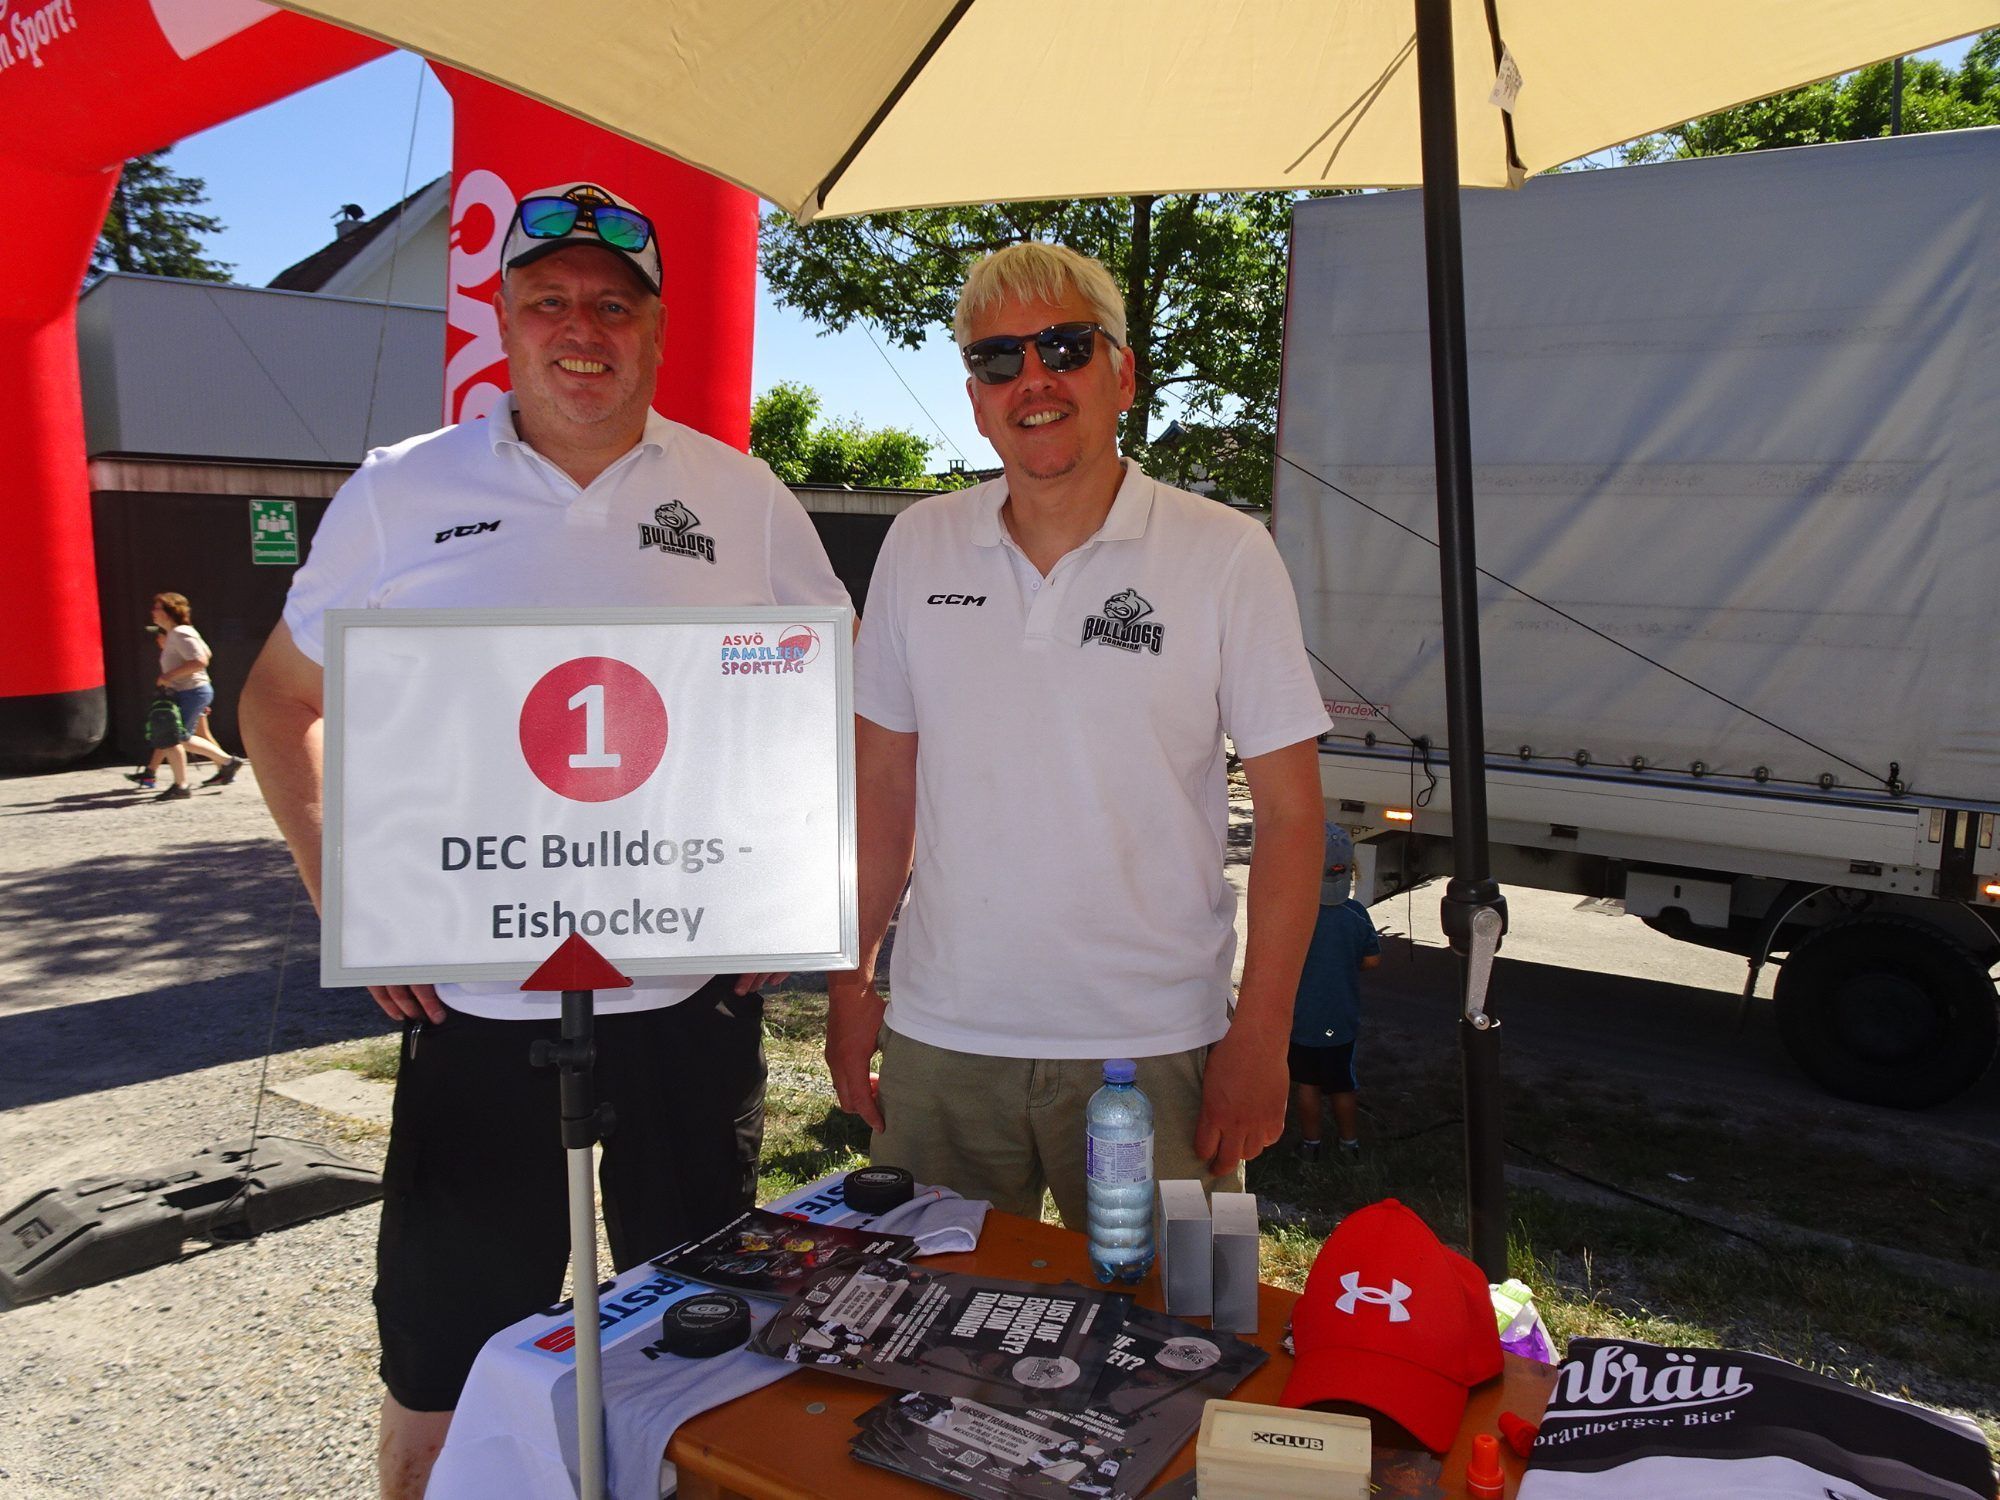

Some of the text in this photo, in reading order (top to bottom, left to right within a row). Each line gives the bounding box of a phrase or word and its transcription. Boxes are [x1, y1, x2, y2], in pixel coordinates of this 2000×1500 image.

[11, 0, 78, 68] Sport!
[435, 520, 502, 543] CCM
[641, 524, 715, 563] BULLDOGS
[927, 594, 987, 607] CCM
[721, 646, 805, 660] FAMILIEN
[722, 632, 764, 646] ASVÖ
[1083, 617, 1163, 653] BULLDOGS
[1102, 636, 1140, 650] DORNBIRN
[721, 660, 804, 675] SPORTTAG
[567, 684, 621, 768] 1
[441, 829, 754, 874] DEC Bulldogs -
[491, 898, 706, 943] Eishockey
[950, 1292, 1001, 1338] TRAINING!
[983, 1293, 1025, 1331] AB ZUM
[998, 1297, 1051, 1355] EISHOCKEY?
[1044, 1298, 1077, 1323] LUST
[1033, 1321, 1064, 1344] AUF
[960, 1405, 988, 1421] UNSERE
[1533, 1409, 1736, 1447] orarlberger Bier
